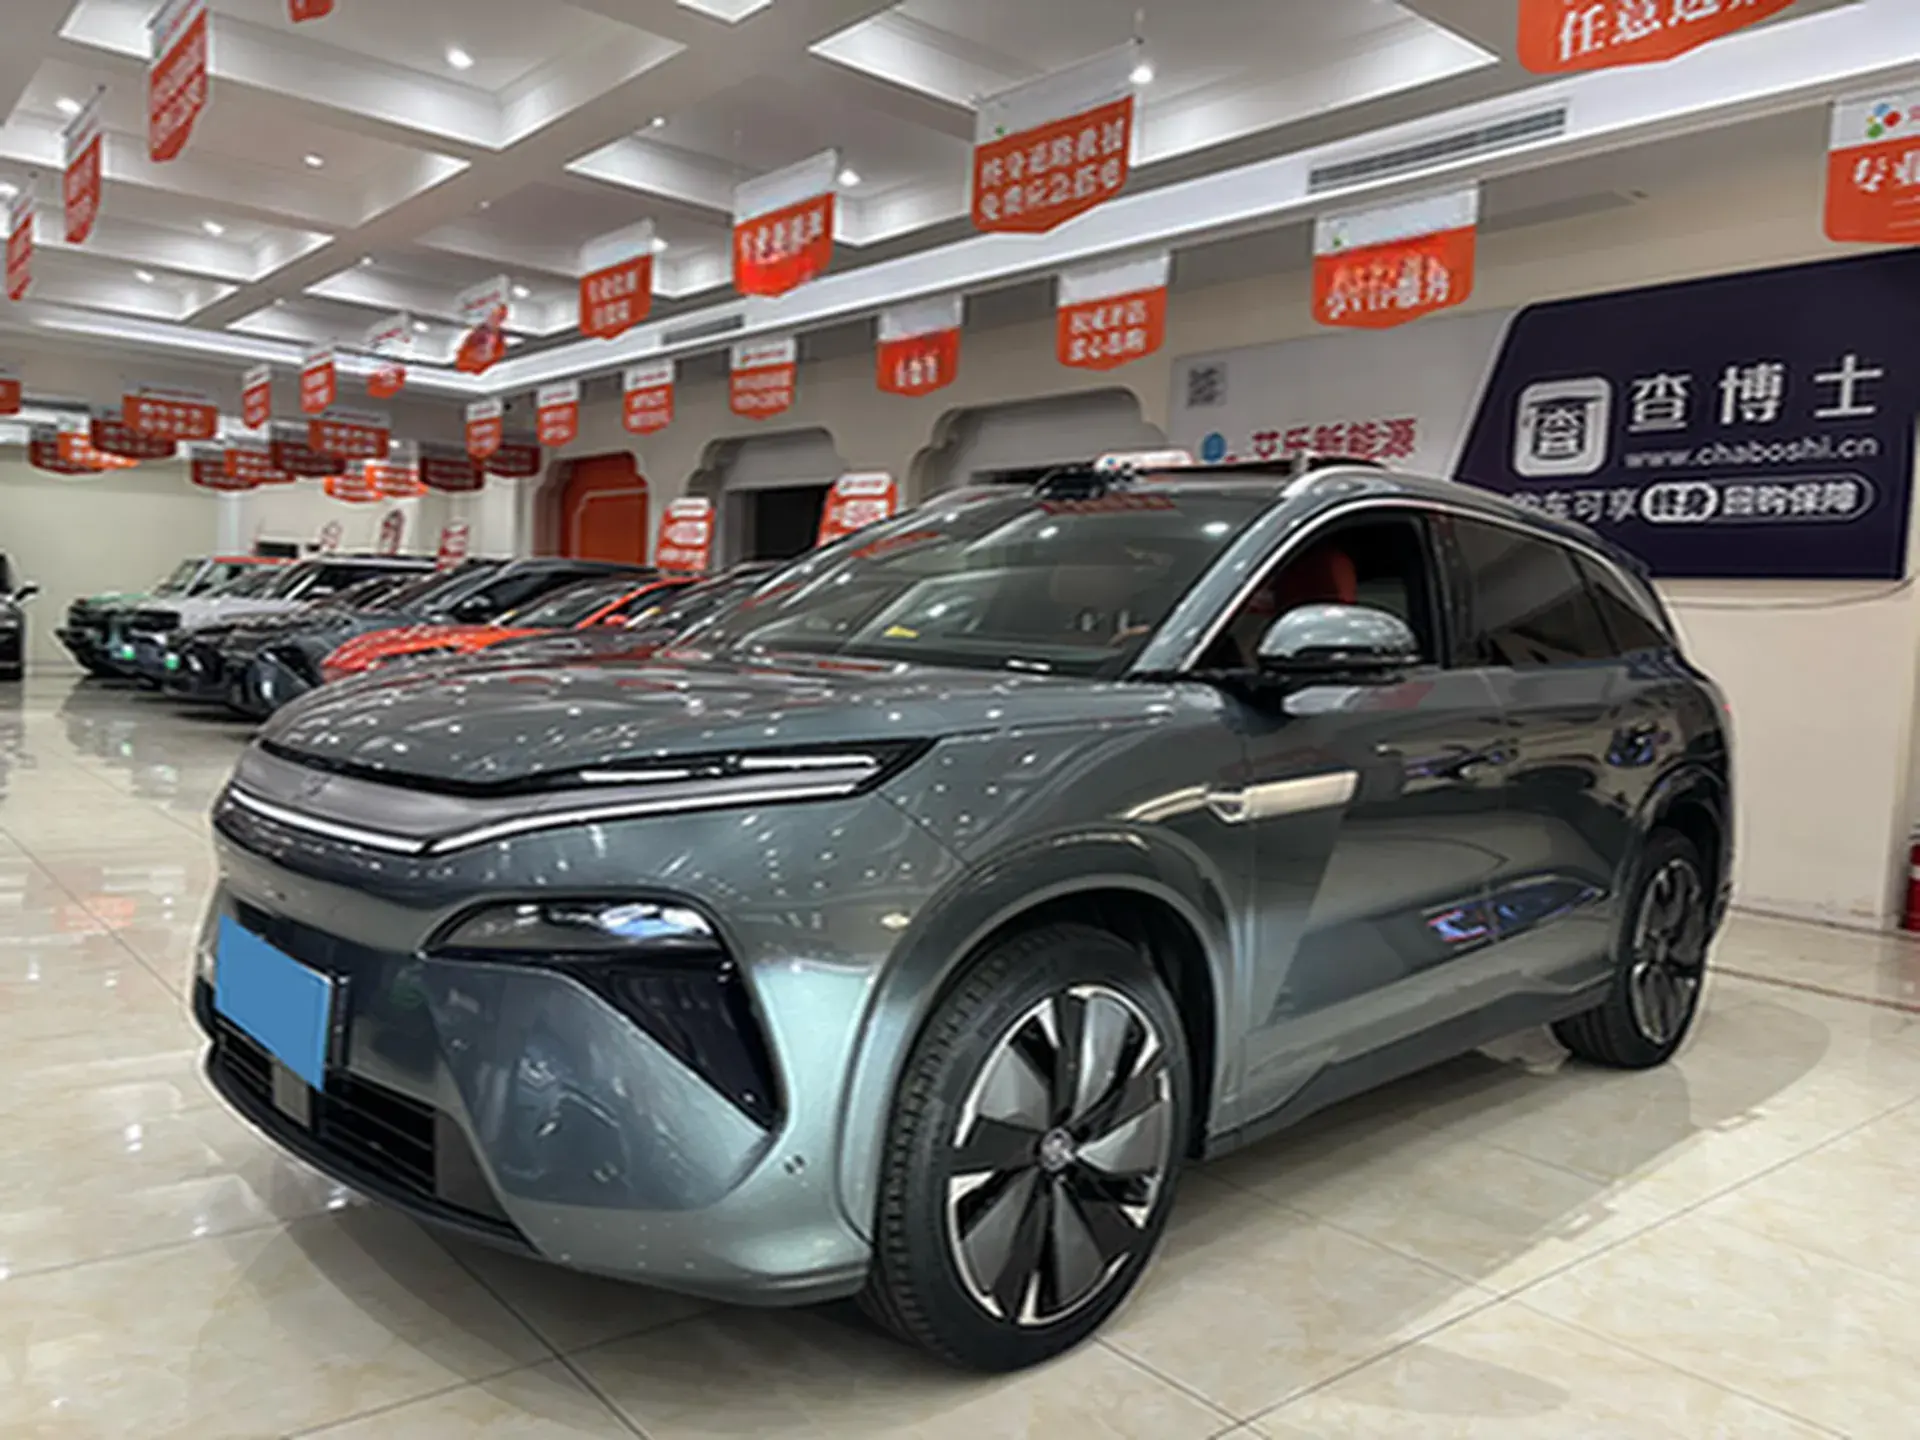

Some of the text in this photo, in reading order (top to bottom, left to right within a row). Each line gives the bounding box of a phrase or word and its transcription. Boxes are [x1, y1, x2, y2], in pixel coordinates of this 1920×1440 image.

[1558, 0, 1758, 62] 任意选
[1627, 354, 1884, 432] 查博士
[1624, 434, 1879, 469] www.chaboshi.cn
